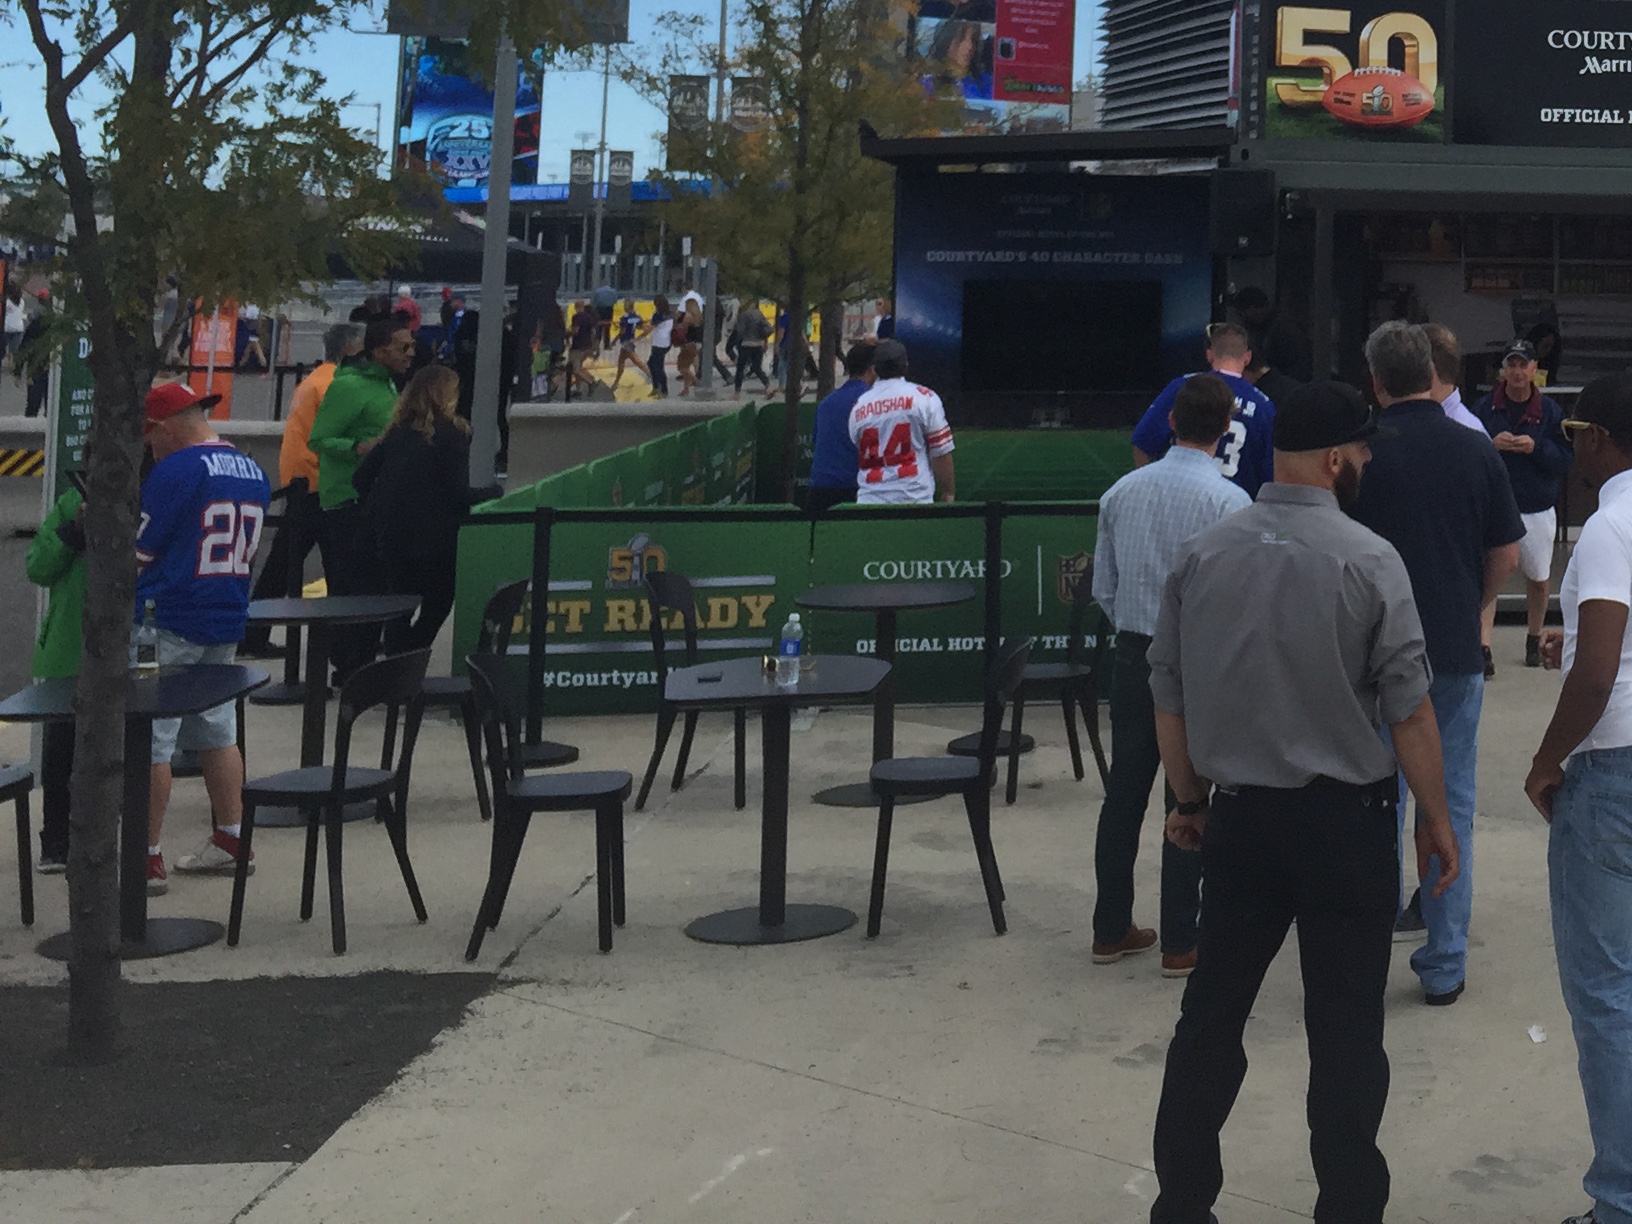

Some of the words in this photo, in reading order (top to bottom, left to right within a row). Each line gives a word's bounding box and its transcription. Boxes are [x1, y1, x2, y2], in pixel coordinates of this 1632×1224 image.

[1275, 5, 1438, 110] 50
[1540, 107, 1624, 125] OFFICIAL
[854, 395, 915, 423] BRADSHAW
[858, 421, 920, 484] 44
[198, 501, 264, 578] 20
